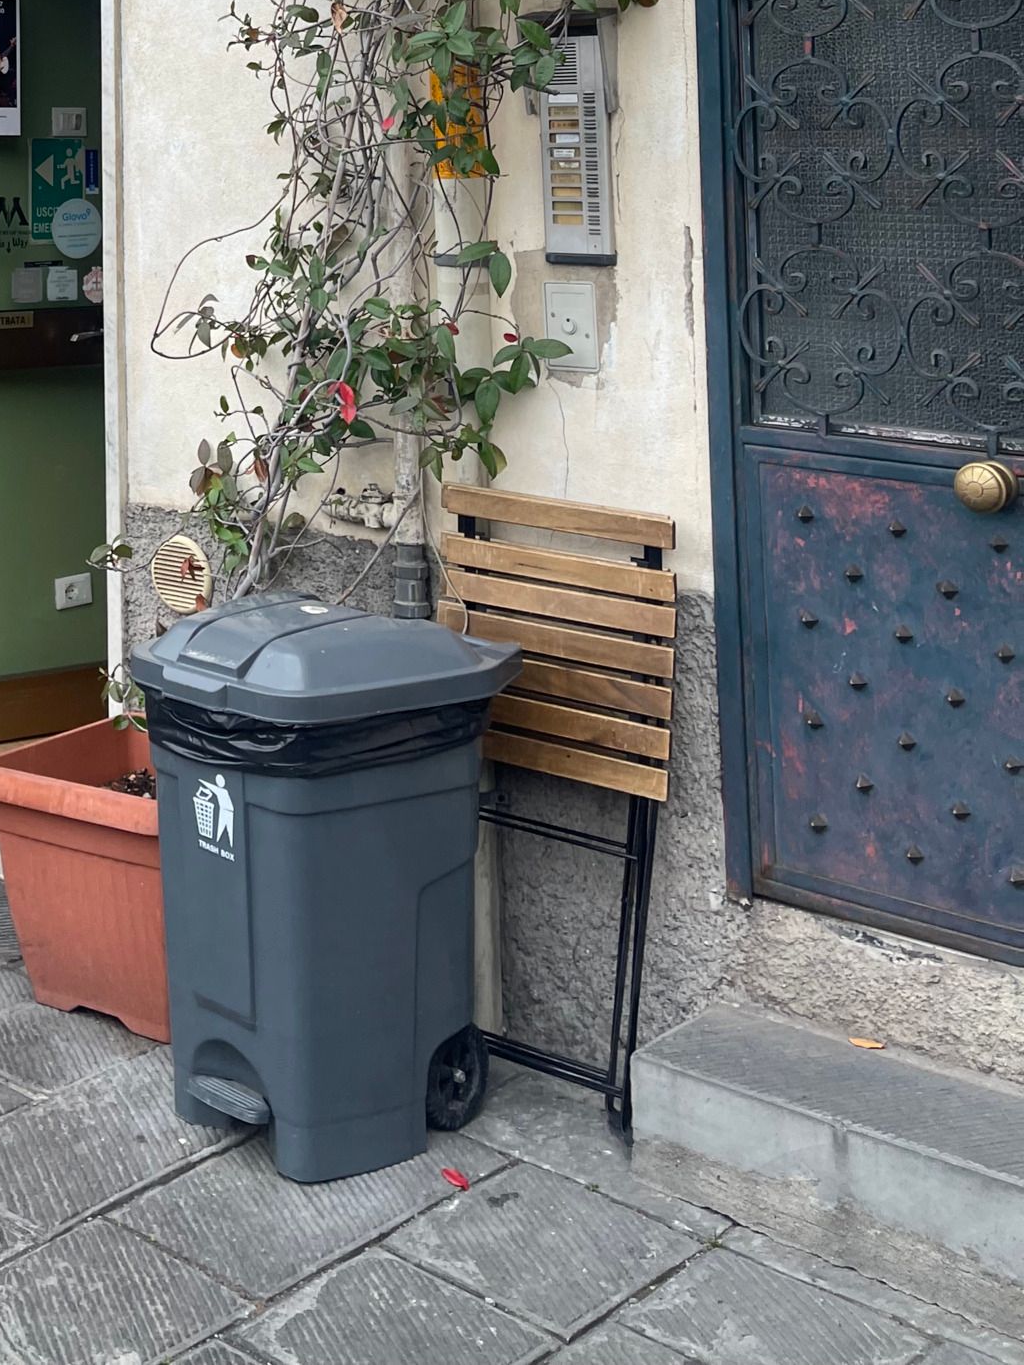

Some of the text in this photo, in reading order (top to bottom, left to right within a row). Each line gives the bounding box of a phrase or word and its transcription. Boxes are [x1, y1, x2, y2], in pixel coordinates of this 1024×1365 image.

[62, 210, 89, 222] Glovo
[198, 839, 236, 862] TRASH BOX
